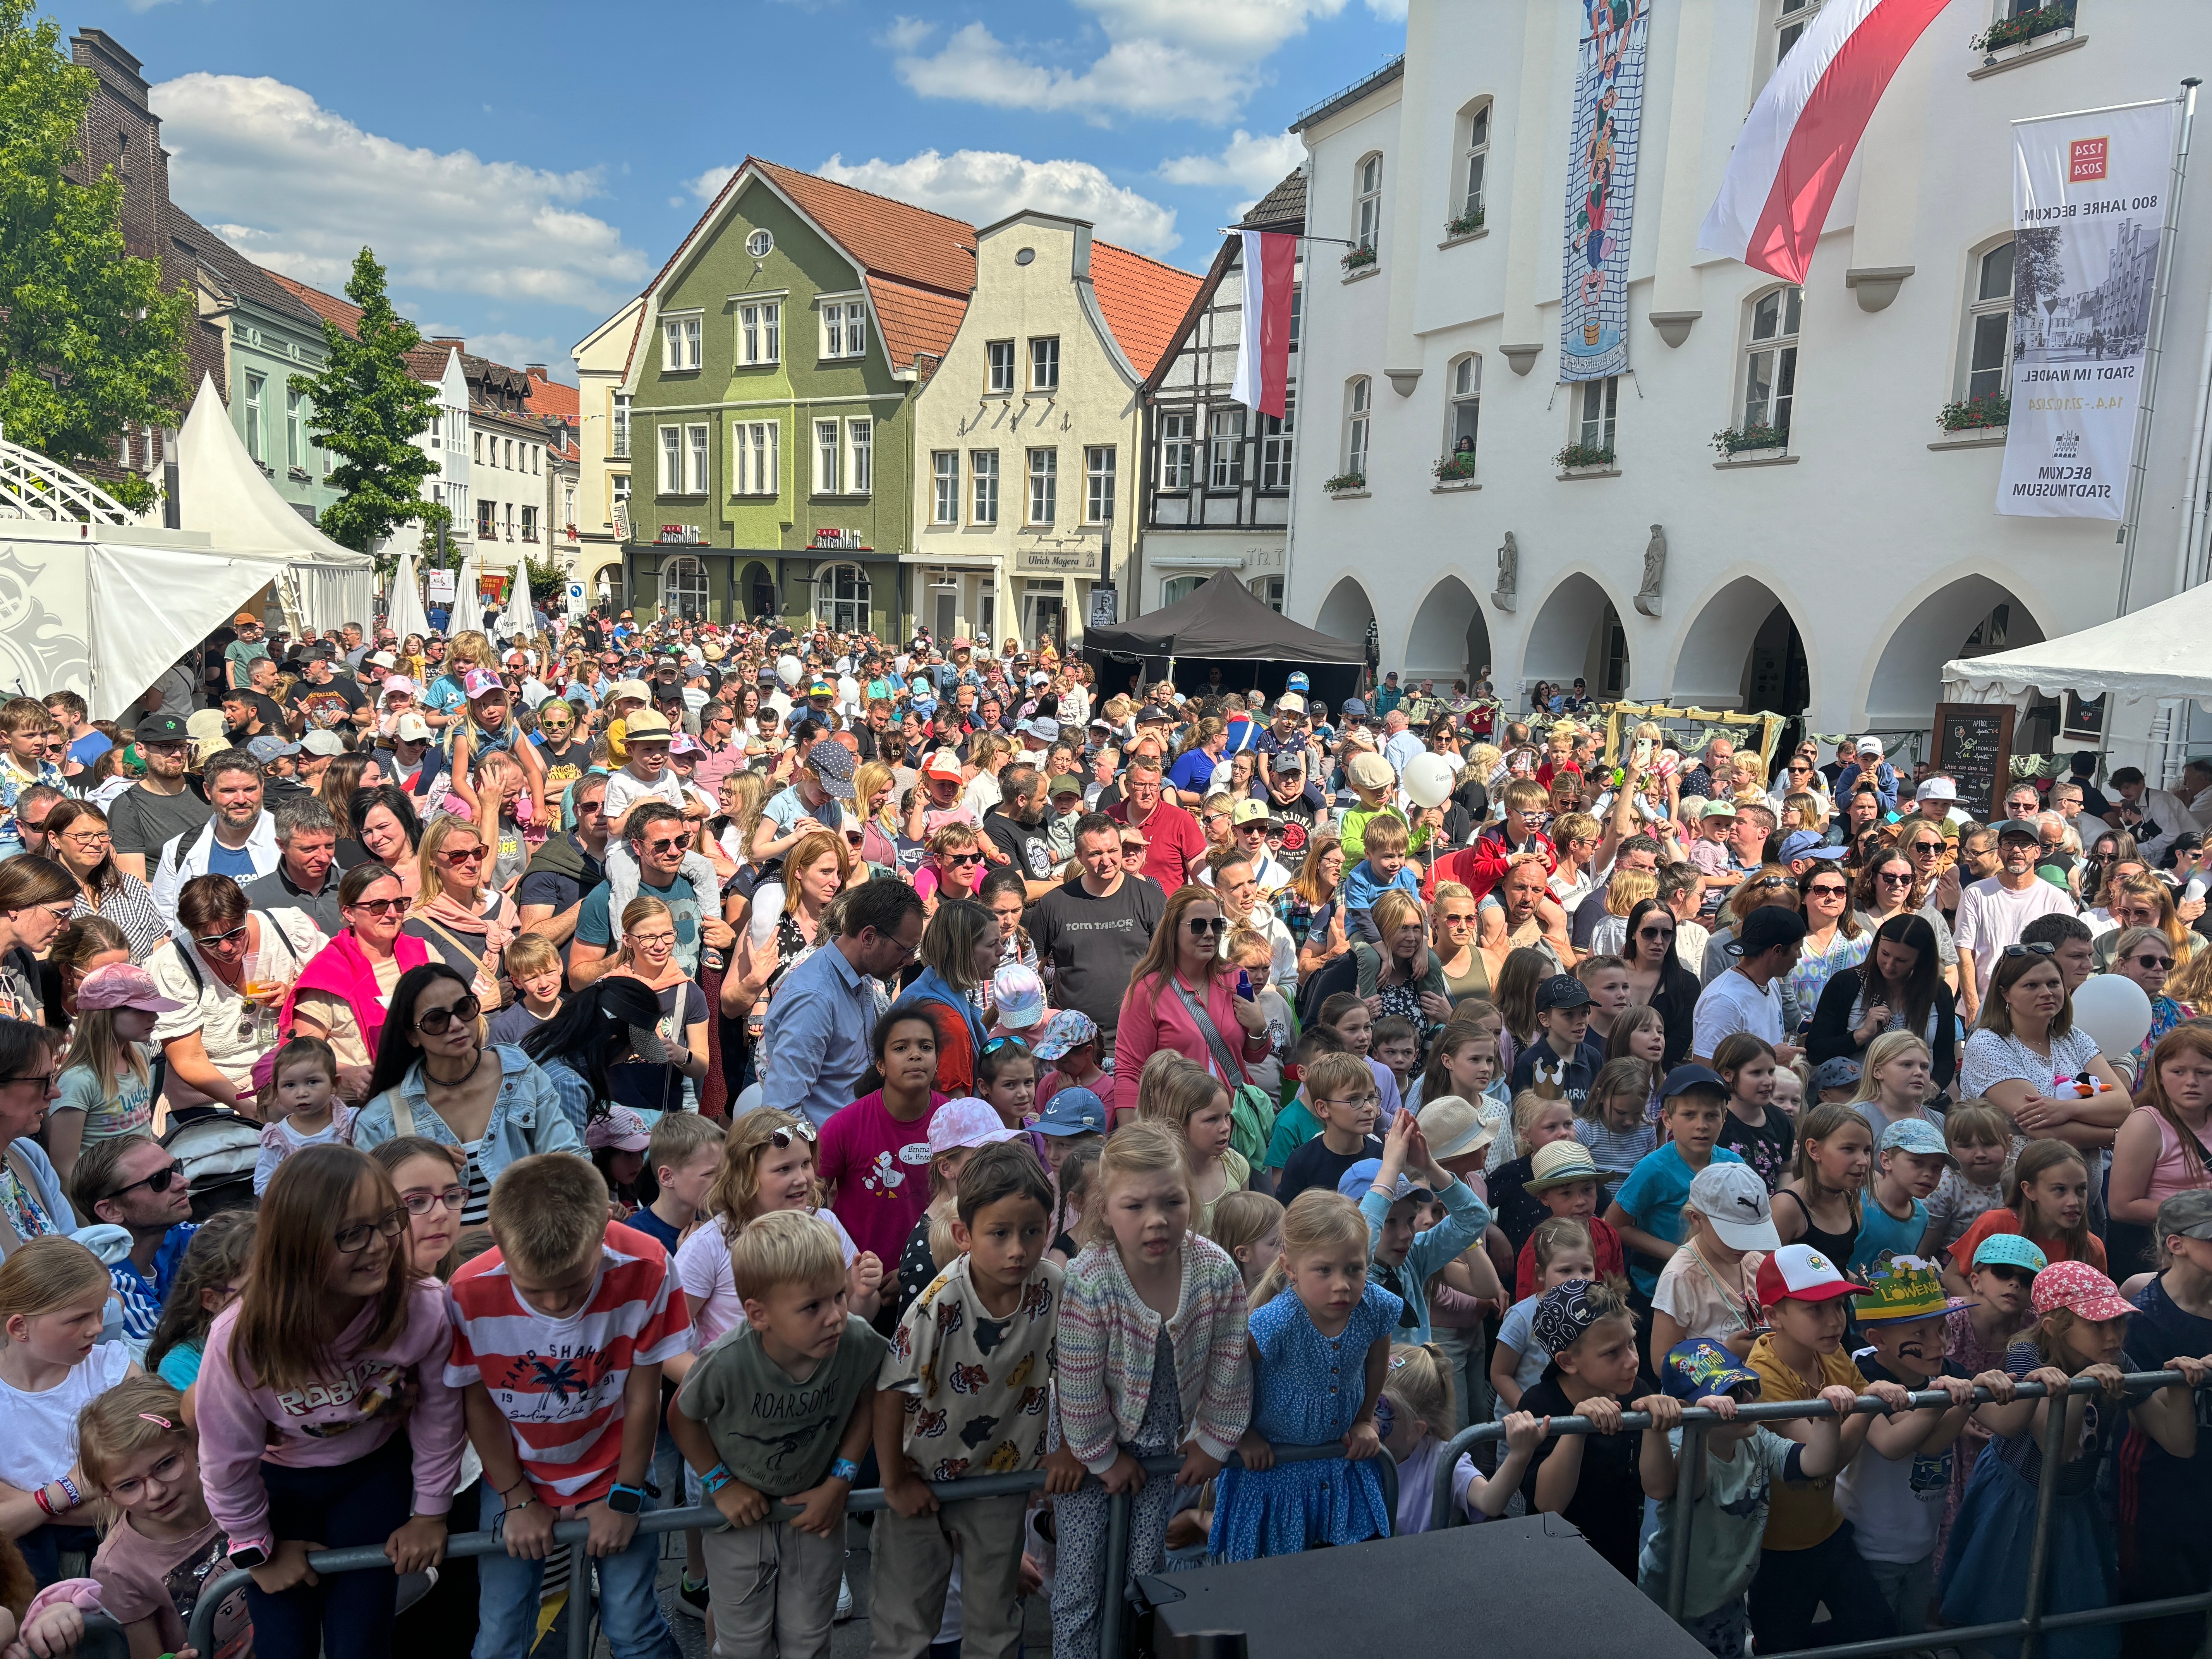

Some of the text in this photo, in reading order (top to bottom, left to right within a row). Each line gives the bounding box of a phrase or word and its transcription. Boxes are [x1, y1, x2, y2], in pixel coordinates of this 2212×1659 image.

[1583, 353, 1617, 369] Püttrologen
[613, 506, 626, 538] extrablatt
[662, 525, 700, 544] extrablatt
[816, 529, 862, 549] extrablatt
[1029, 556, 1079, 567] Ulrich Magera
[1066, 922, 1092, 931] TOM
[1094, 919, 1133, 930] TAILOR
[501, 1349, 537, 1390] CAMP
[603, 1374, 615, 1386] 91
[502, 1393, 512, 1403] 19
[509, 1409, 554, 1422] Surfing
